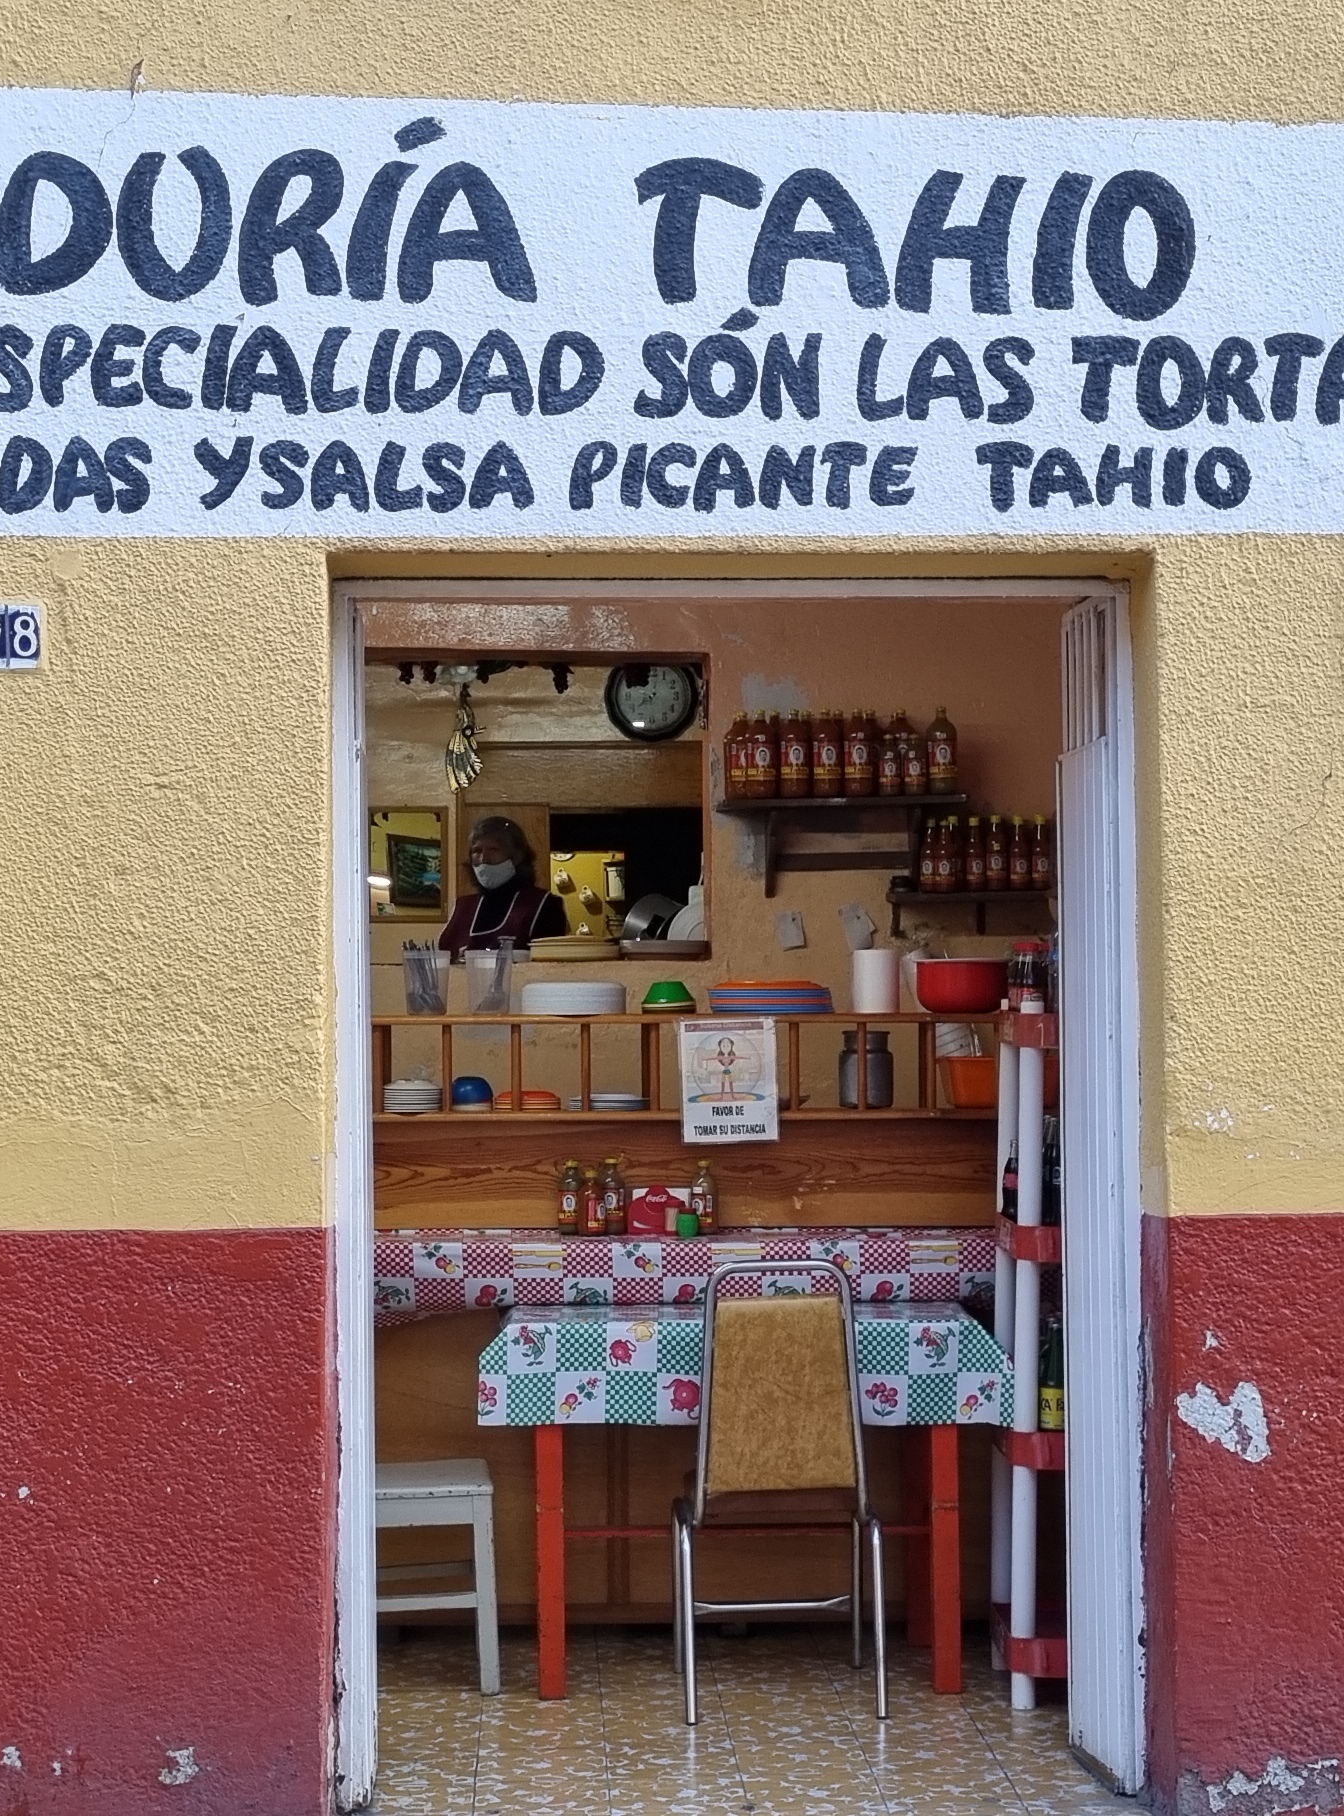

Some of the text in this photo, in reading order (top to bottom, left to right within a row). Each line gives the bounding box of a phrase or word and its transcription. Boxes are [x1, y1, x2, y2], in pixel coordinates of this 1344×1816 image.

[635, 157, 1195, 321] TAHIO
[634, 309, 821, 420] SÓN
[857, 333, 1035, 424] LAS
[569, 441, 916, 512] PICANTE
[976, 441, 1250, 512] TAHIO
[693, 1123, 766, 1136] TOMAR SU DISTANCIA
[711, 1105, 745, 1117] FAVOR DE
